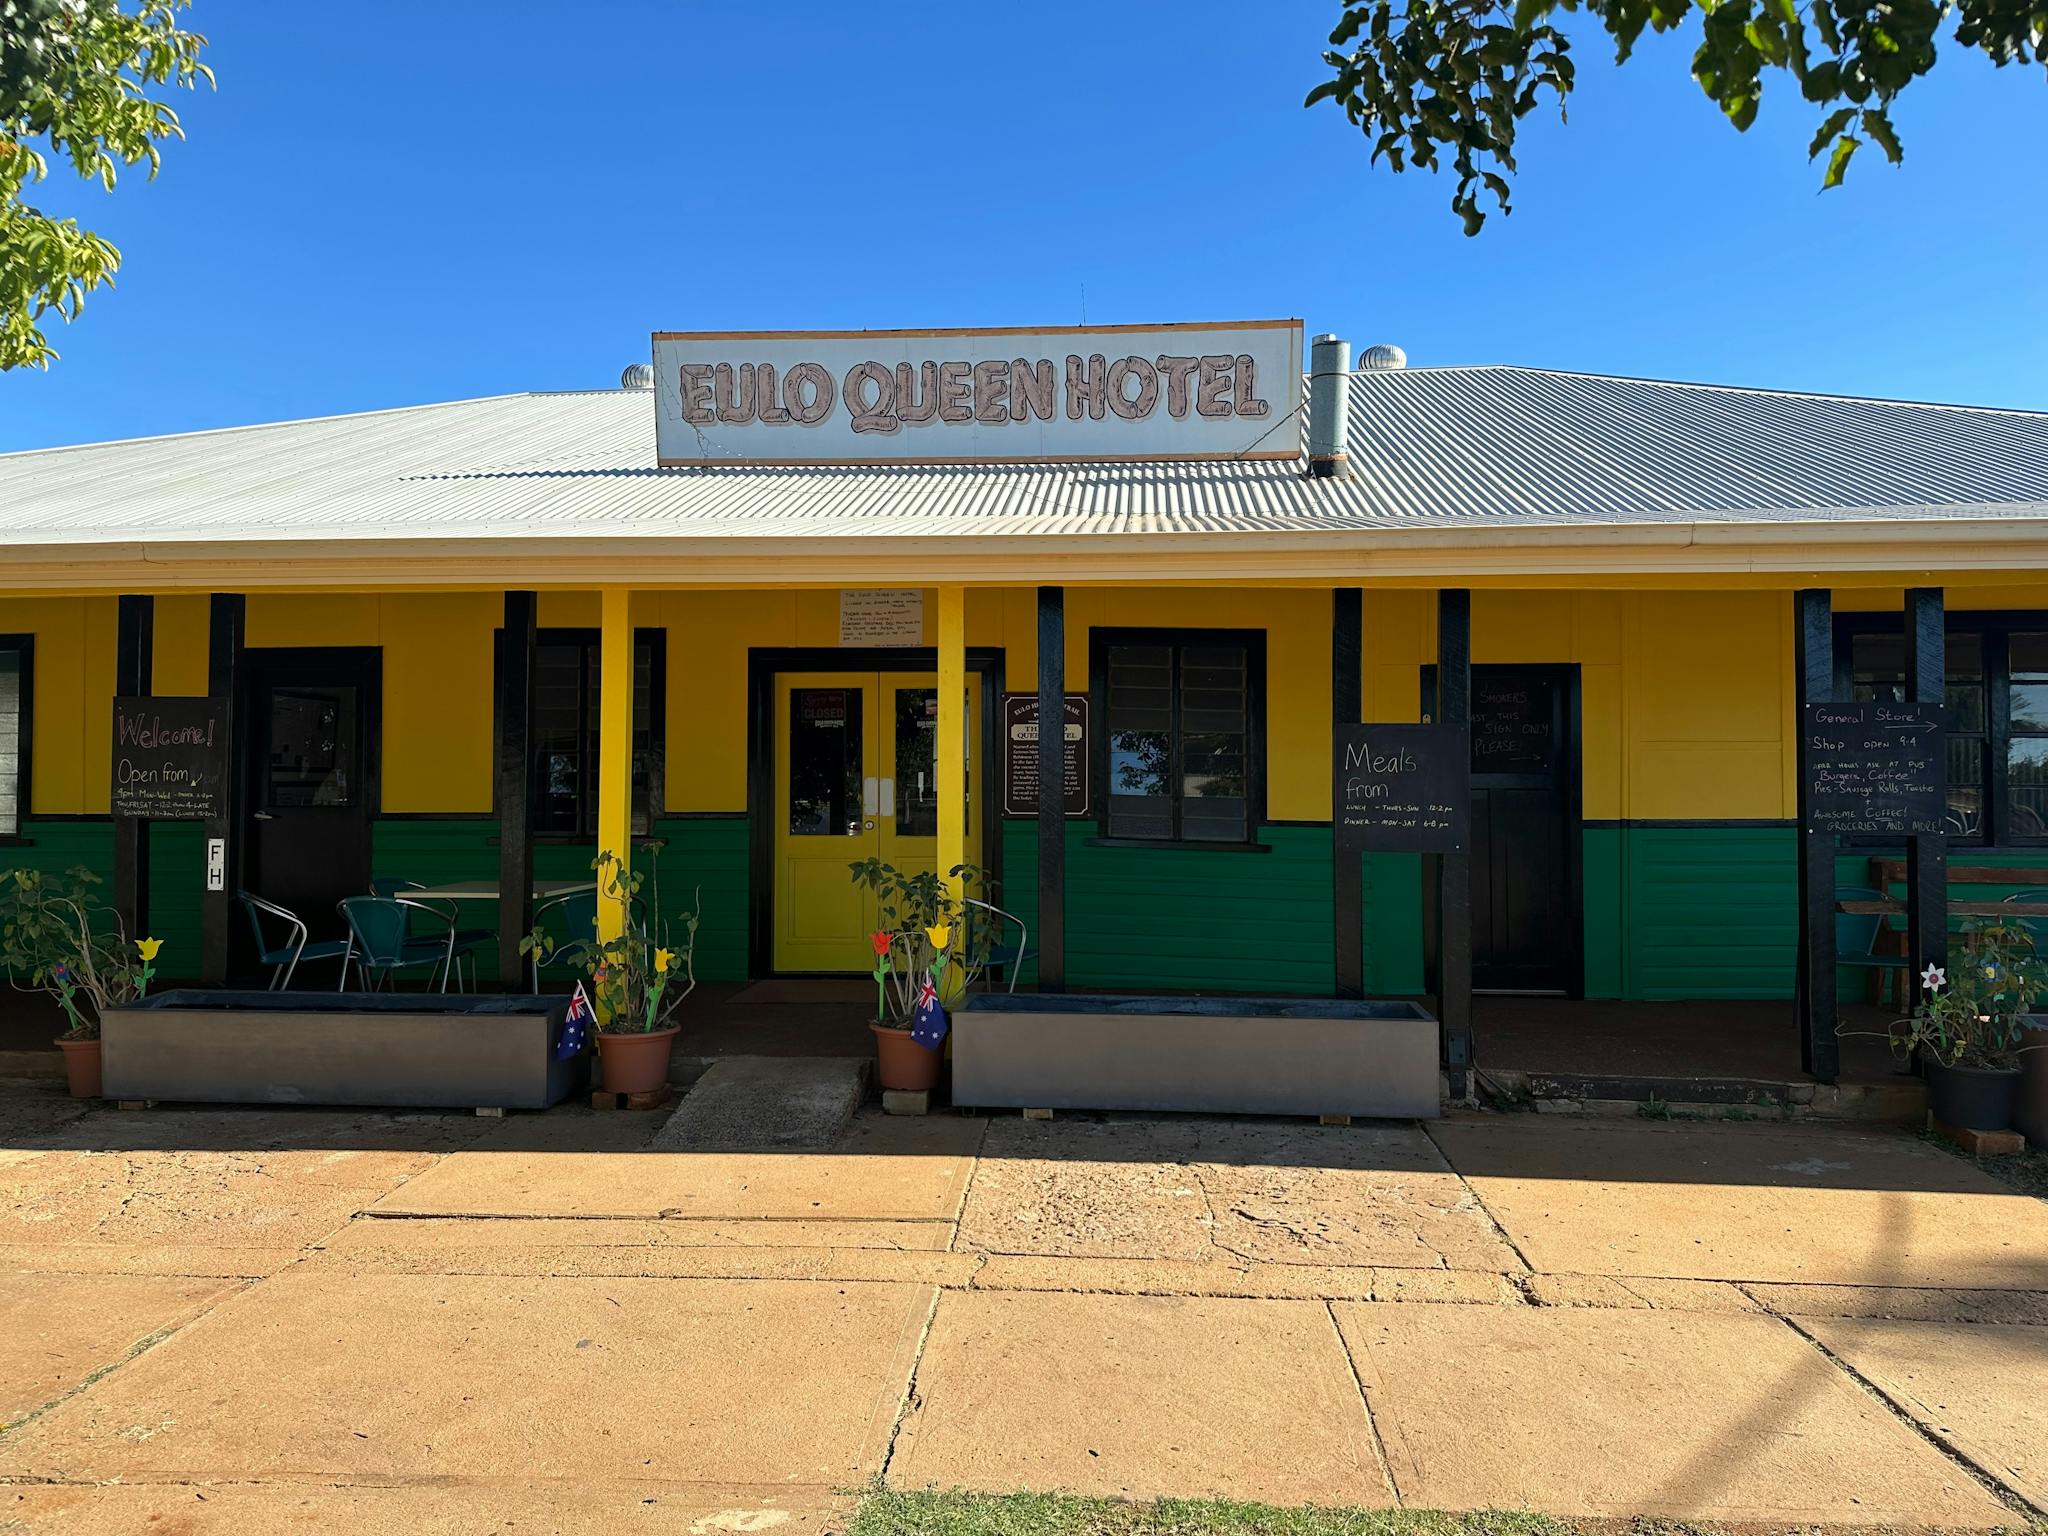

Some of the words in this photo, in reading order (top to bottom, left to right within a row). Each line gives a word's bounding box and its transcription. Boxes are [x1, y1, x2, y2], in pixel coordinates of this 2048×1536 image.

[681, 361, 833, 424] EULO
[844, 357, 1054, 433] QUEEN
[1066, 353, 1269, 421] HOTEL
[1479, 690, 1528, 704] SMOKERS
[804, 707, 844, 719] CLOSED
[1496, 712, 1520, 721] THIS
[1815, 707, 1864, 723] General
[119, 713, 215, 749] Welcome!
[1483, 722, 1513, 735] SIGN
[1521, 723, 1549, 737] ONLY
[1474, 738, 1518, 756] PLEASE
[1812, 736, 1845, 751] Shop
[1345, 743, 1417, 774] Meals
[118, 758, 158, 791] Open
[163, 762, 189, 782] from
[1346, 776, 1389, 800] from
[1346, 804, 1366, 812] LUNCH
[1344, 817, 1371, 825] DINNER
[1381, 819, 1416, 827] MON-SAT
[1827, 821, 1878, 832] GROCERIES
[1886, 821, 1904, 831] AND
